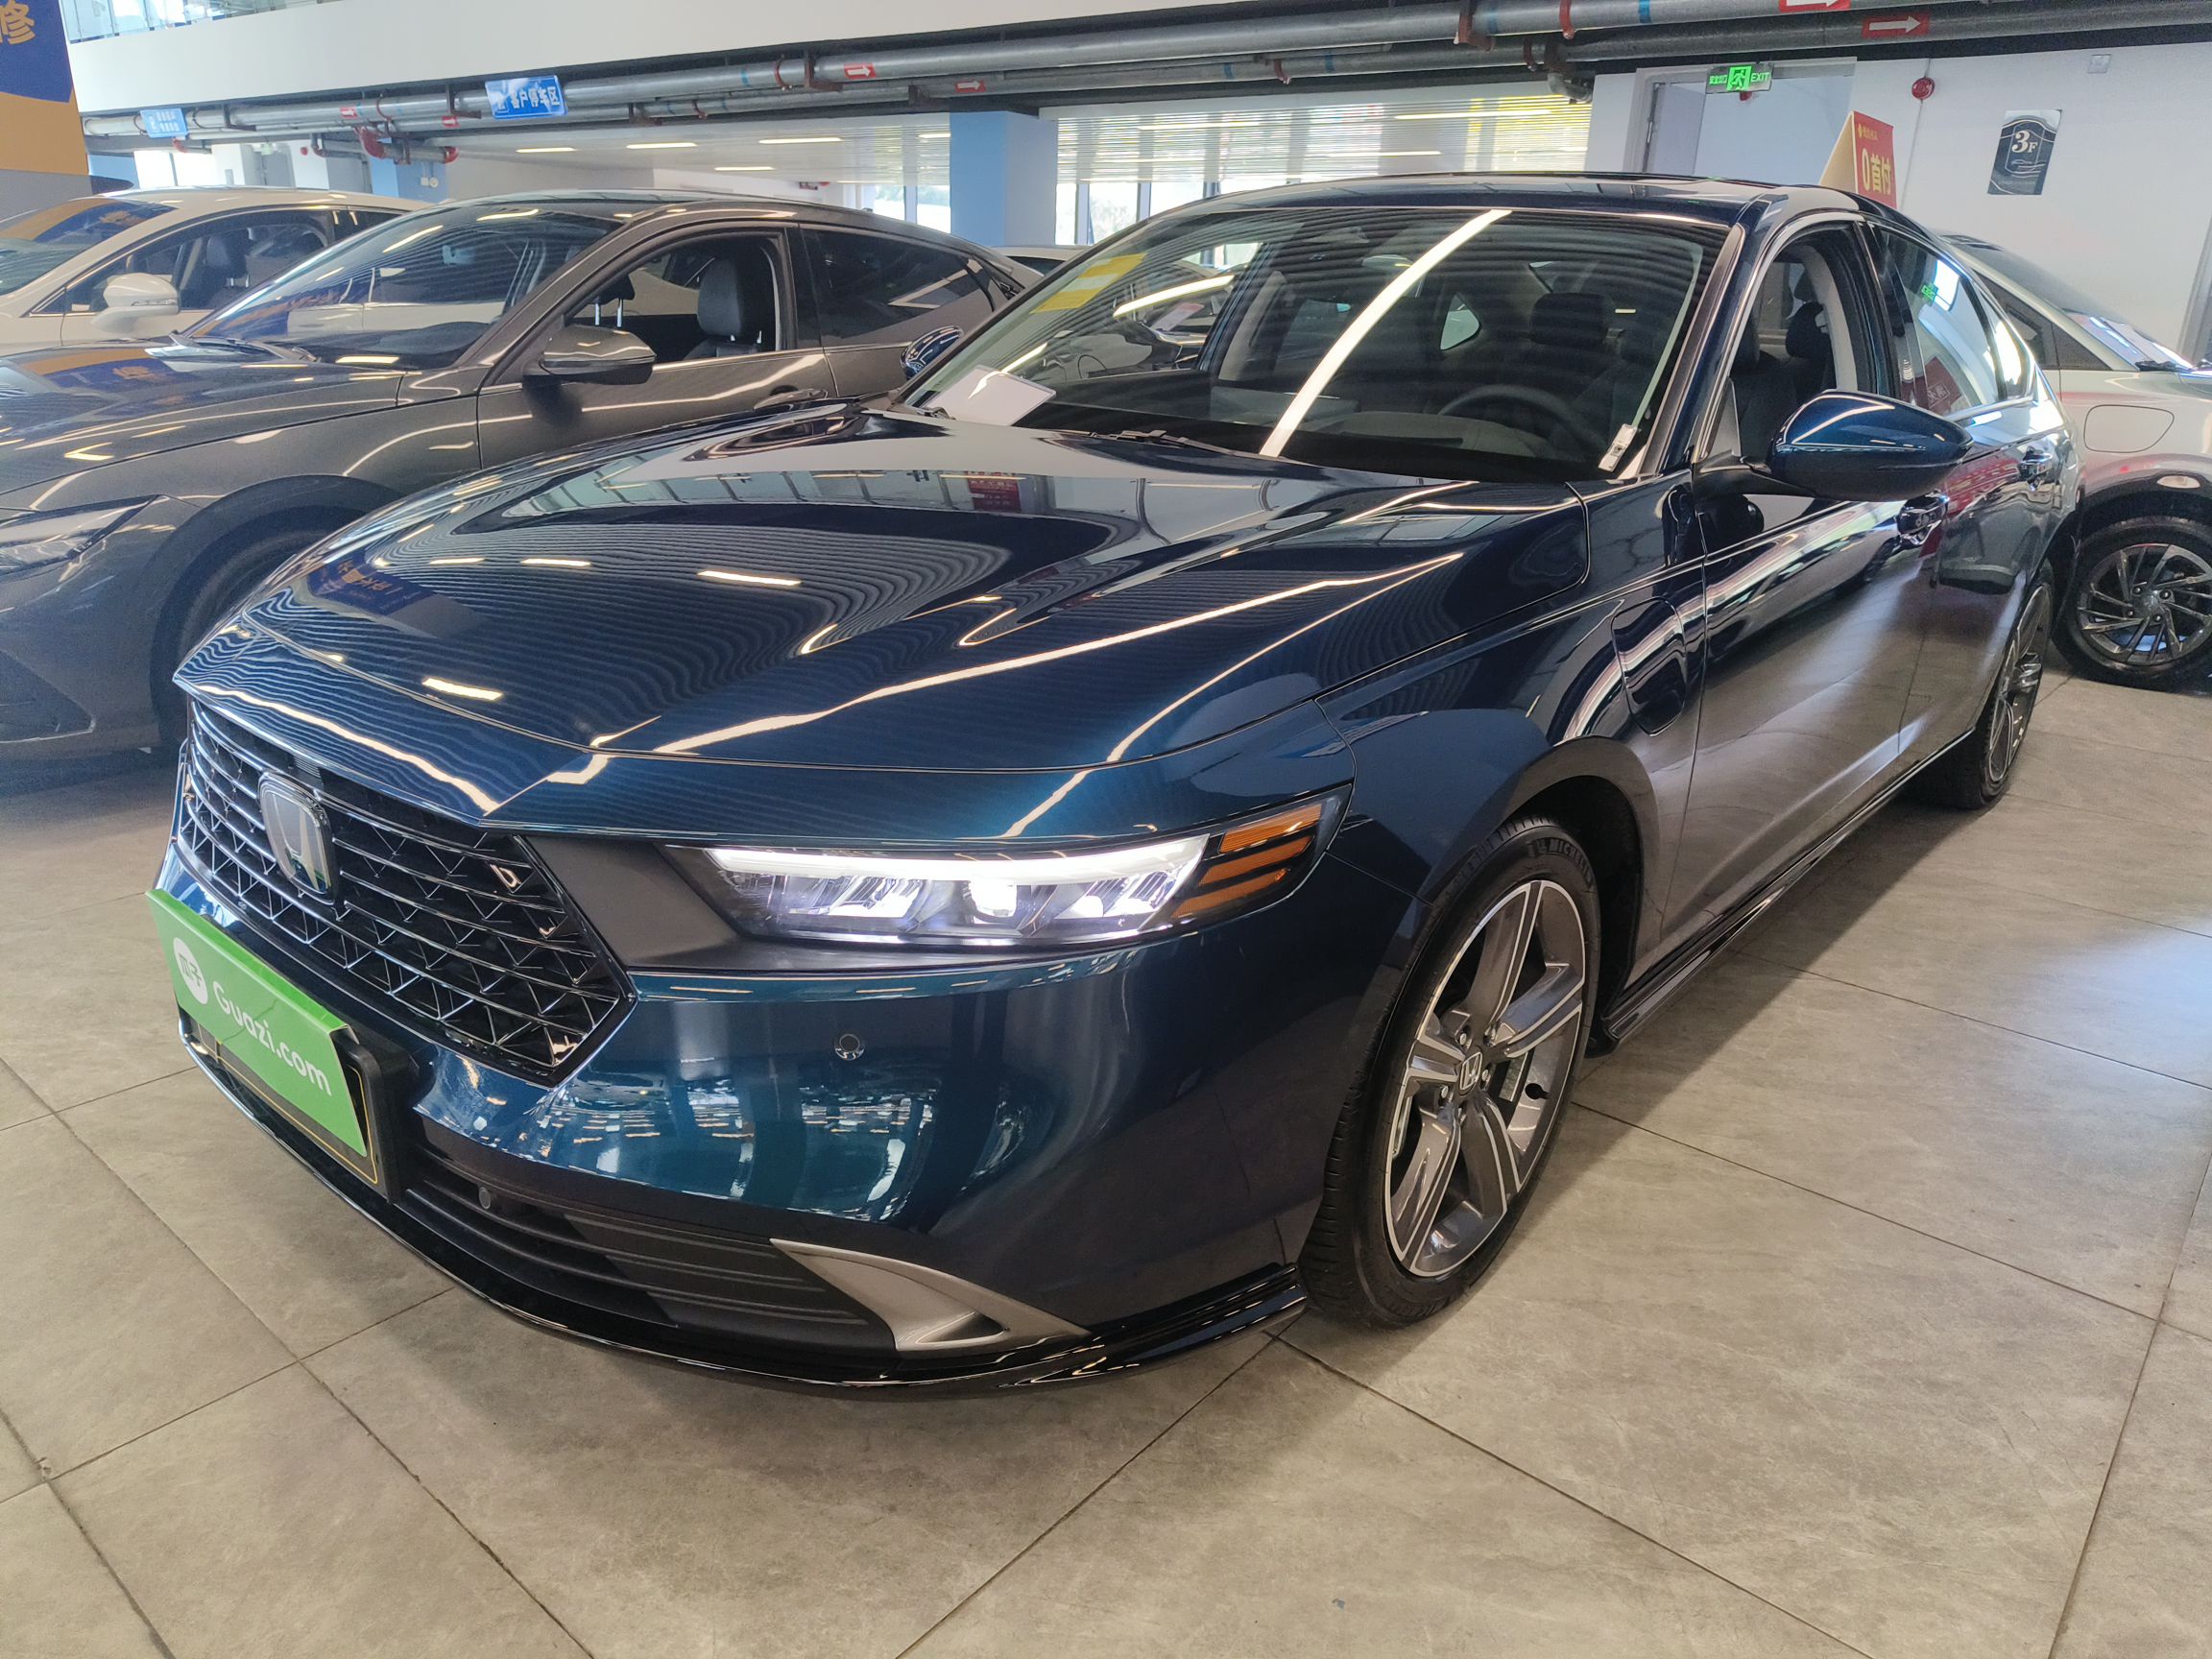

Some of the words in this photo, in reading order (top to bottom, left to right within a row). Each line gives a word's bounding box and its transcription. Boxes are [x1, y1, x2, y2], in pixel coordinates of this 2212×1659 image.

[1750, 72, 1770, 83] EXIT
[2011, 130, 2038, 154] 3F
[1862, 147, 1890, 195] 0首付
[212, 980, 332, 1097] Guazi.com
